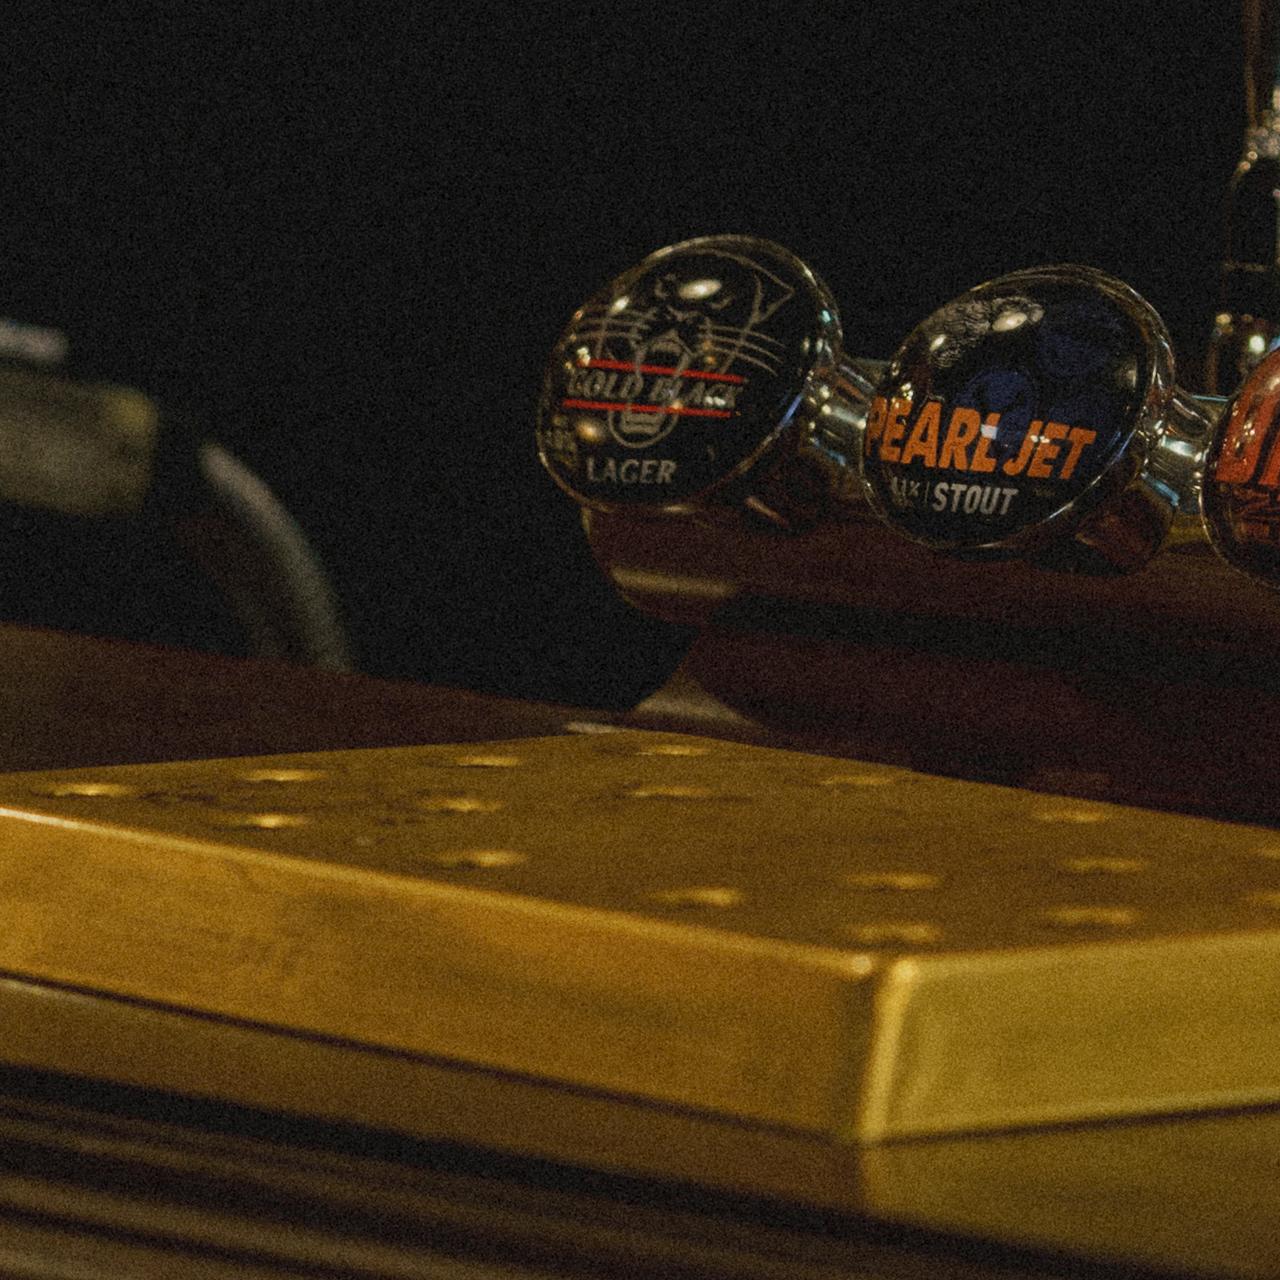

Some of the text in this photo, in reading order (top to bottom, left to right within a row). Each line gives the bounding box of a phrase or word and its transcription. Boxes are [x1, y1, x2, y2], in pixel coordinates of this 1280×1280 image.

[865, 395, 1097, 480] PEARL JET
[586, 453, 679, 484] LAGER
[932, 481, 1019, 515] STOUT
